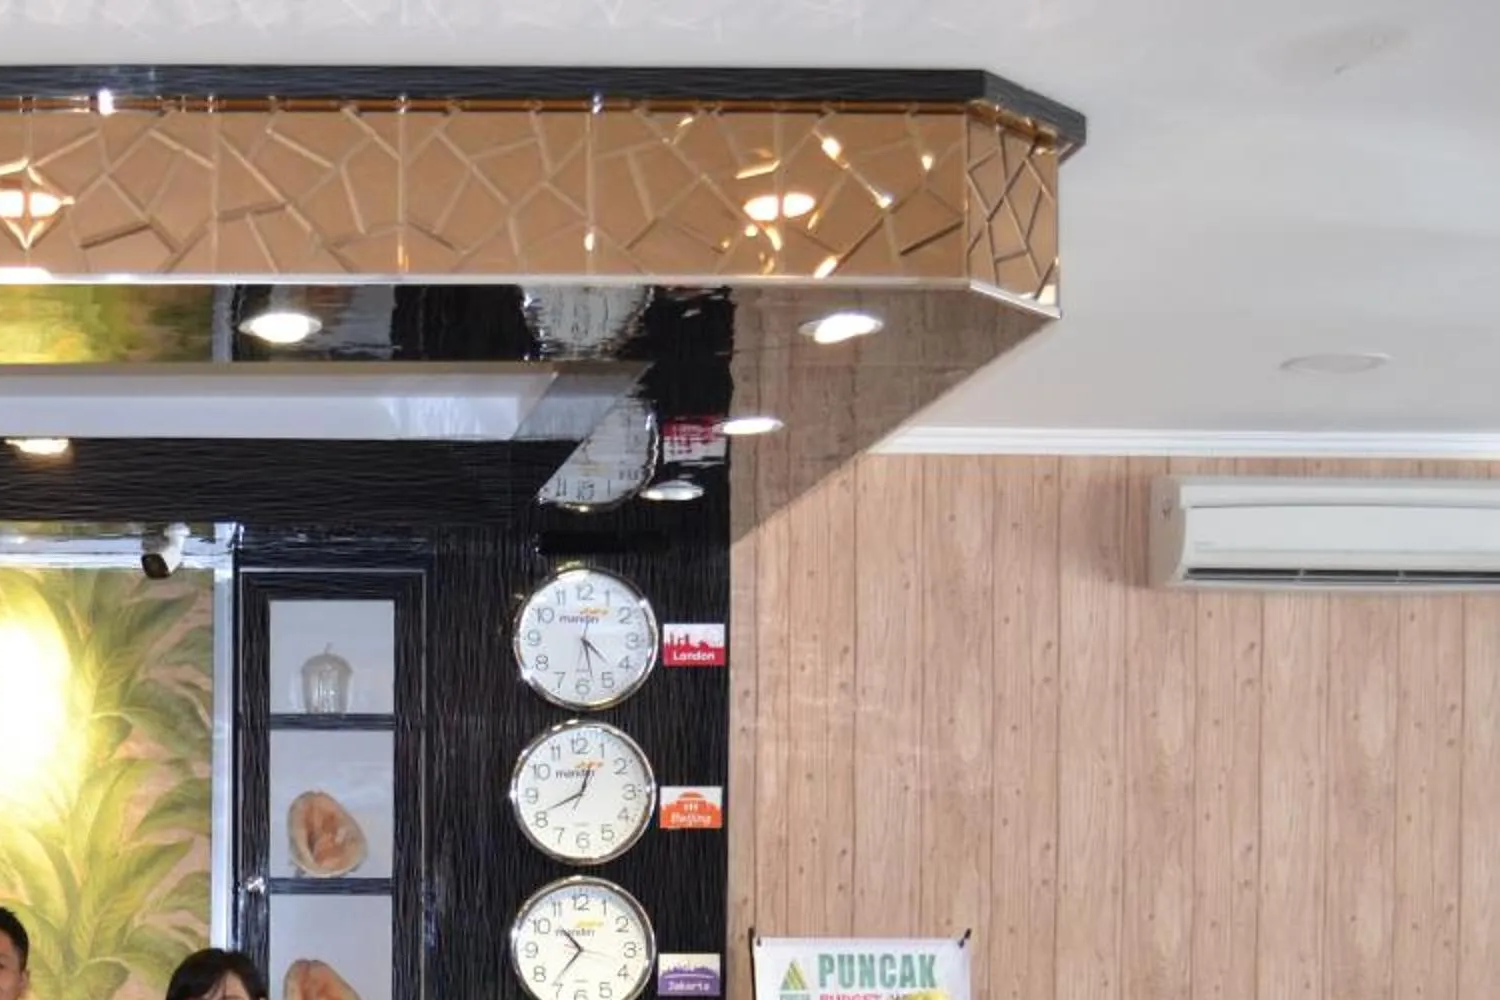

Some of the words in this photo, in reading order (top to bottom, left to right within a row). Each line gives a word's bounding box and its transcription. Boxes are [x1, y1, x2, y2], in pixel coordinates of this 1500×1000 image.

[556, 590, 566, 605] 11
[578, 582, 594, 601] 12
[536, 607, 555, 624] 10
[619, 607, 632, 624] 2
[528, 631, 541, 646] 9
[626, 633, 638, 649] 3
[536, 655, 548, 671] 8
[619, 655, 631, 672] 4
[672, 650, 715, 661] London
[556, 672, 566, 688] 7
[576, 679, 590, 695] 6
[601, 671, 614, 689] 5
[551, 744, 561, 759] 11
[571, 737, 588, 754] 12
[533, 763, 551, 780] 10
[614, 758, 629, 775] 2
[525, 787, 538, 803] 9
[622, 784, 636, 801] 3
[535, 811, 548, 828] 8
[618, 808, 630, 822] 4
[554, 828, 565, 844] 7
[575, 831, 590, 848] 6
[601, 824, 614, 841] 5
[553, 901, 562, 916] 11
[572, 894, 589, 911] 12
[533, 918, 551, 935] 10
[616, 916, 629, 933] 2
[525, 941, 538, 958] 9
[624, 941, 637, 959] 3
[533, 966, 546, 982] 8
[617, 964, 629, 982] 4
[818, 953, 937, 988] PUNCAK
[552, 984, 563, 1000] 7
[599, 982, 613, 999] 5
[667, 980, 710, 991] Jakarta
